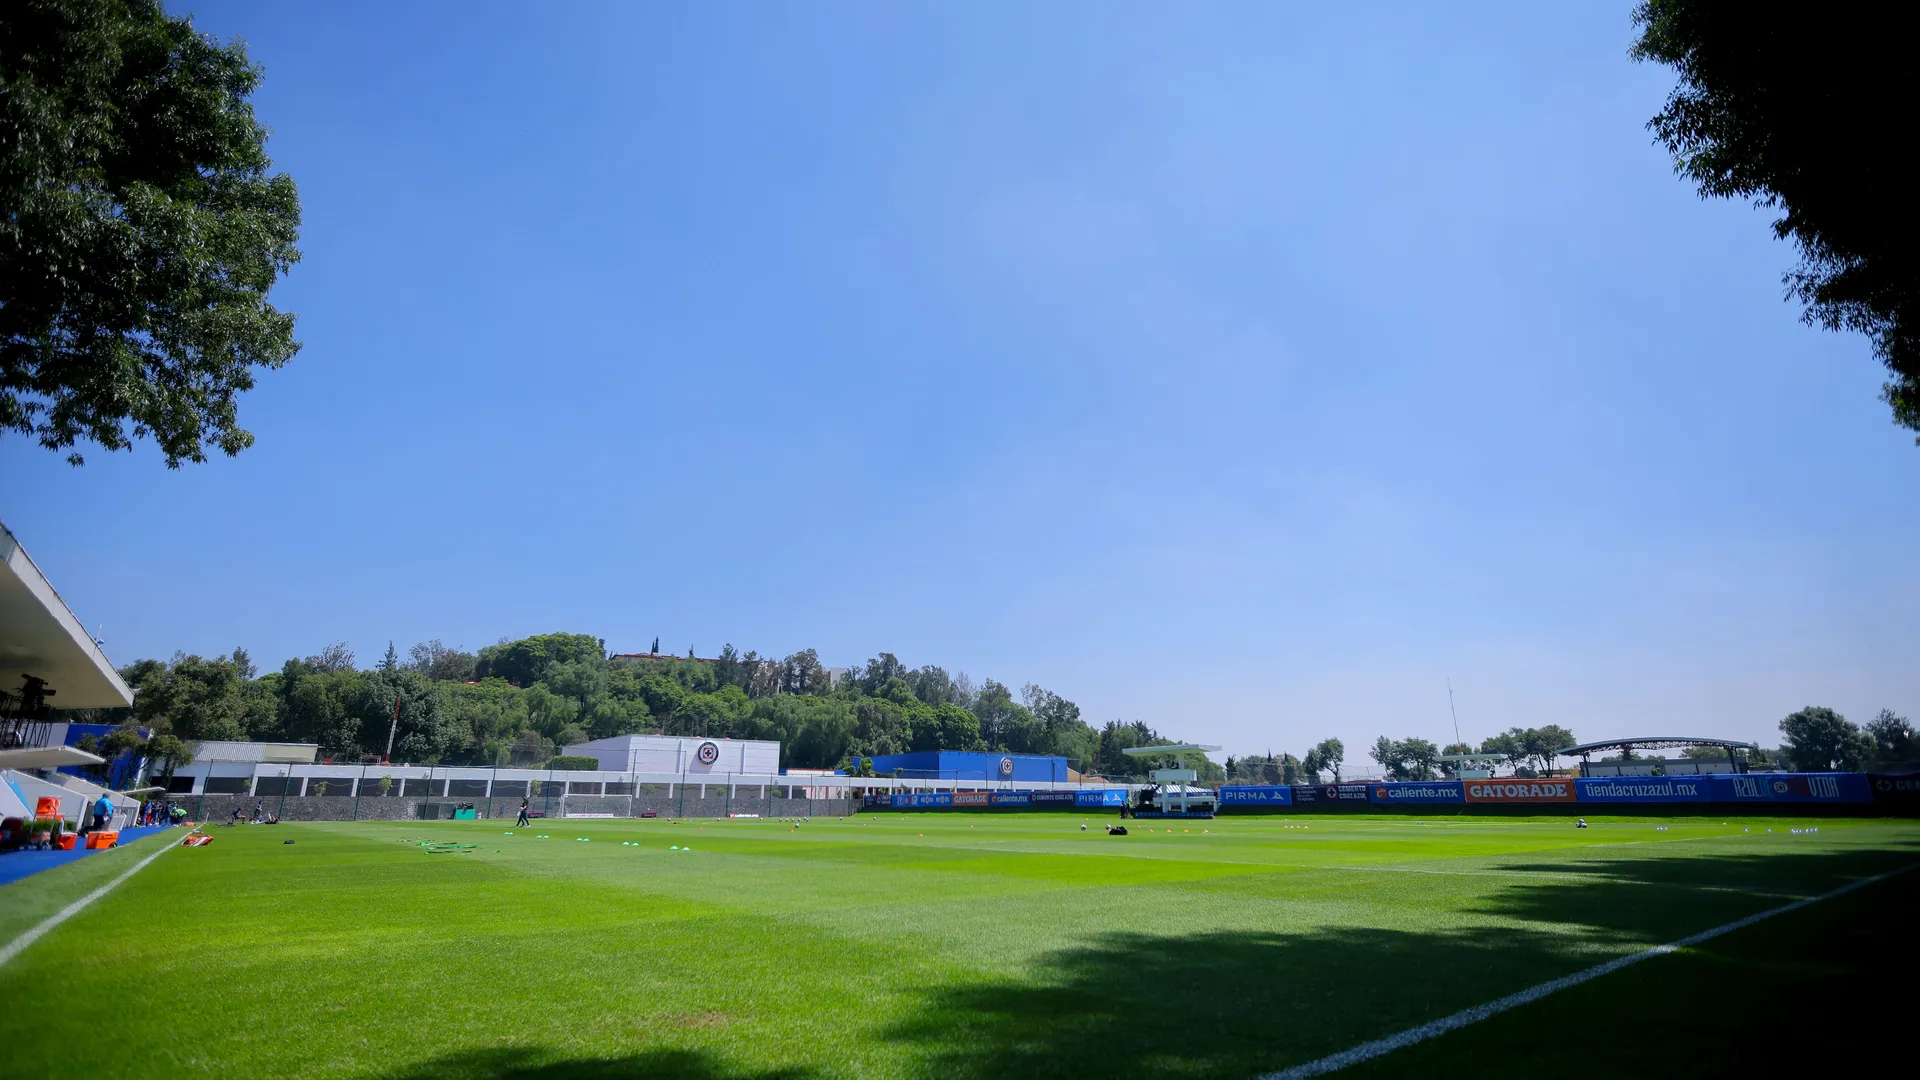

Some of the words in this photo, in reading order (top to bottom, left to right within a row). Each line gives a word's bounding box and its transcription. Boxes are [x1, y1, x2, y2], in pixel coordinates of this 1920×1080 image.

[1469, 784, 1568, 798] GATORADE
[1585, 781, 1698, 797] tiendacruzazul.mx
[1733, 778, 1762, 797] AZUL
[1807, 777, 1840, 797] VIDA
[1225, 791, 1267, 800] PIRMA
[1388, 787, 1458, 798] caliente.mx
[954, 795, 987, 804] GATORADE
[997, 795, 1028, 803] caliente.mx
[1078, 794, 1109, 802] PIRMA
